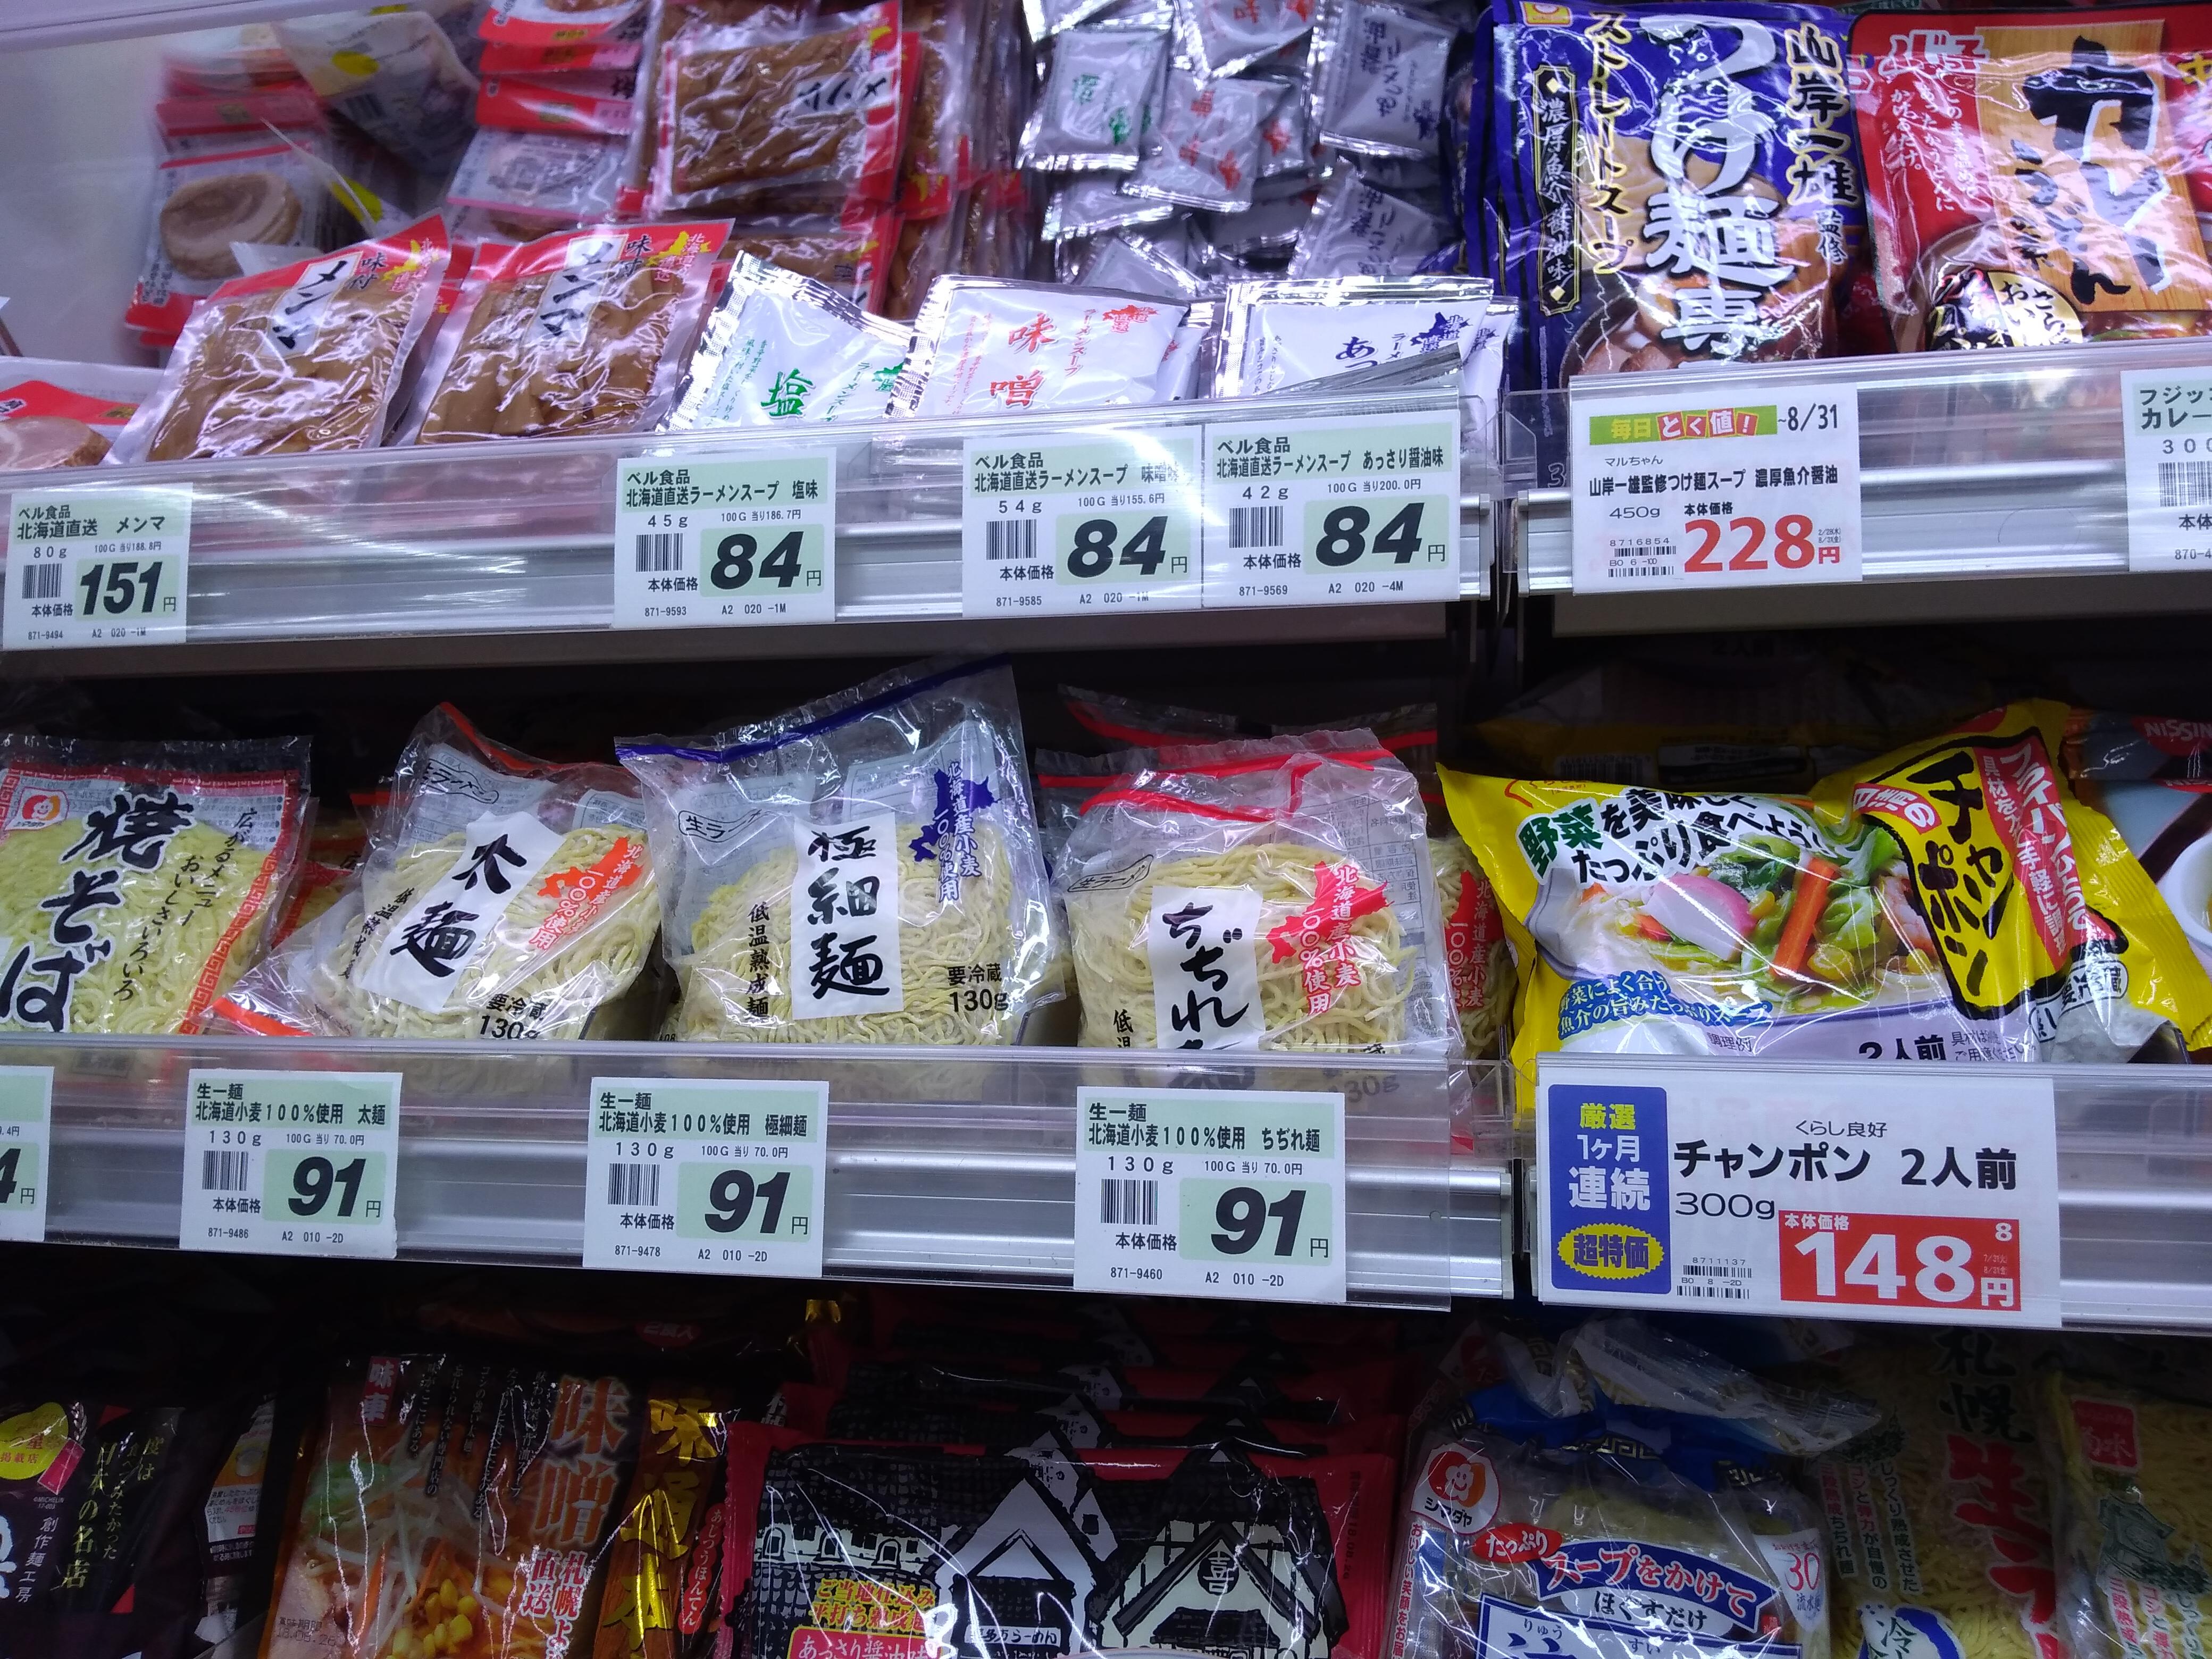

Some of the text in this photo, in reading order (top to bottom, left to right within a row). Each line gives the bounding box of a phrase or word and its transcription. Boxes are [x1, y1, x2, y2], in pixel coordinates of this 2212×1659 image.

[991, 313, 1056, 406] 味噌
[761, 369, 814, 417] 塩
[2140, 386, 2212, 405] フジッ
[1217, 437, 1290, 455] ベル食品
[975, 452, 1043, 470] ベル食品
[1217, 446, 1443, 479] 北海道直送ラーメンスープ あっさり醤油味
[1605, 455, 1663, 467] マルちゃん
[627, 469, 690, 485] ベル食品
[974, 464, 1128, 492] 北海道直送ラーメンスープ
[1589, 465, 1838, 497] 山岸一雄監修つけ麺スープ 濃厚魚介醤油
[626, 480, 818, 508] 北海道直送ラーメンスープ 塩味
[18, 505, 71, 520] ベル食品
[1609, 507, 1660, 519] 450g
[1685, 502, 1733, 516] 本体価格
[17, 516, 166, 540] 北海道直送 メンマ
[1610, 538, 1670, 547] 8716854
[1243, 553, 1301, 569] 本体価格
[1000, 565, 1054, 581] 本体価格
[648, 577, 698, 592] 本体価格
[1239, 585, 1288, 596] 871-9569
[31, 604, 73, 617] 本体価格
[645, 606, 686, 617] 871-9593
[722, 605, 733, 615] A2
[744, 604, 761, 614] 020
[996, 596, 1042, 607] 871-9585
[28, 630, 63, 640] 871-9494
[948, 762, 982, 876] 北海道産小麦
[181, 808, 257, 927] 広がるメニュー
[0, 795, 194, 1032] 焼そば
[389, 833, 527, 978] 太麺
[807, 825, 890, 1001] 極細麺
[113, 856, 204, 1001] おいしさいろいろ
[1326, 865, 1361, 988] 北海道産小麦
[747, 903, 770, 1018] 低温熟成麺
[948, 963, 1002, 984] 要冷蔵
[949, 989, 1008, 1012] 130g
[1707, 1032, 1753, 1052] 調理例
[197, 1083, 244, 1100] 生一麺
[600, 1092, 652, 1110] 生一麺
[357, 1104, 386, 1125] 太麺
[1088, 1102, 1146, 1121] 生一麺
[1579, 1103, 1636, 1130] 厳選
[765, 1114, 807, 1137] 極細麺
[1795, 1119, 1888, 1138] くらし良好
[1262, 1127, 1320, 1152] ちぢれ麺
[1674, 1141, 2017, 1190] チャンポン 2人前
[1568, 1166, 1650, 1212] 連続
[213, 1197, 261, 1213] 本体価格
[1675, 1192, 1775, 1220] 300g
[620, 1213, 675, 1230] 本体価格
[1784, 1214, 1849, 1231] 本体価格
[208, 1228, 248, 1238] 871-9486
[1116, 1232, 1177, 1251] 本体価格
[615, 1245, 660, 1257] 871-9478
[1572, 1234, 1649, 1268] 超特価
[1111, 1267, 1162, 1280] 871-9460
[1205, 1272, 1219, 1284] A2
[1233, 1273, 1254, 1286] 010
[532, 1375, 630, 1545] 味噌
[1423, 1496, 1473, 1529] シマダヤ
[1485, 1527, 1548, 1557] たっぷり
[15, 1516, 60, 1603] 創作麺工房
[683, 1508, 723, 1626] あじつうほんてん
[1545, 1545, 1758, 1617] スープをかけて
[1784, 1552, 1820, 1591] 30
[1523, 1618, 1564, 1639] りゅう
